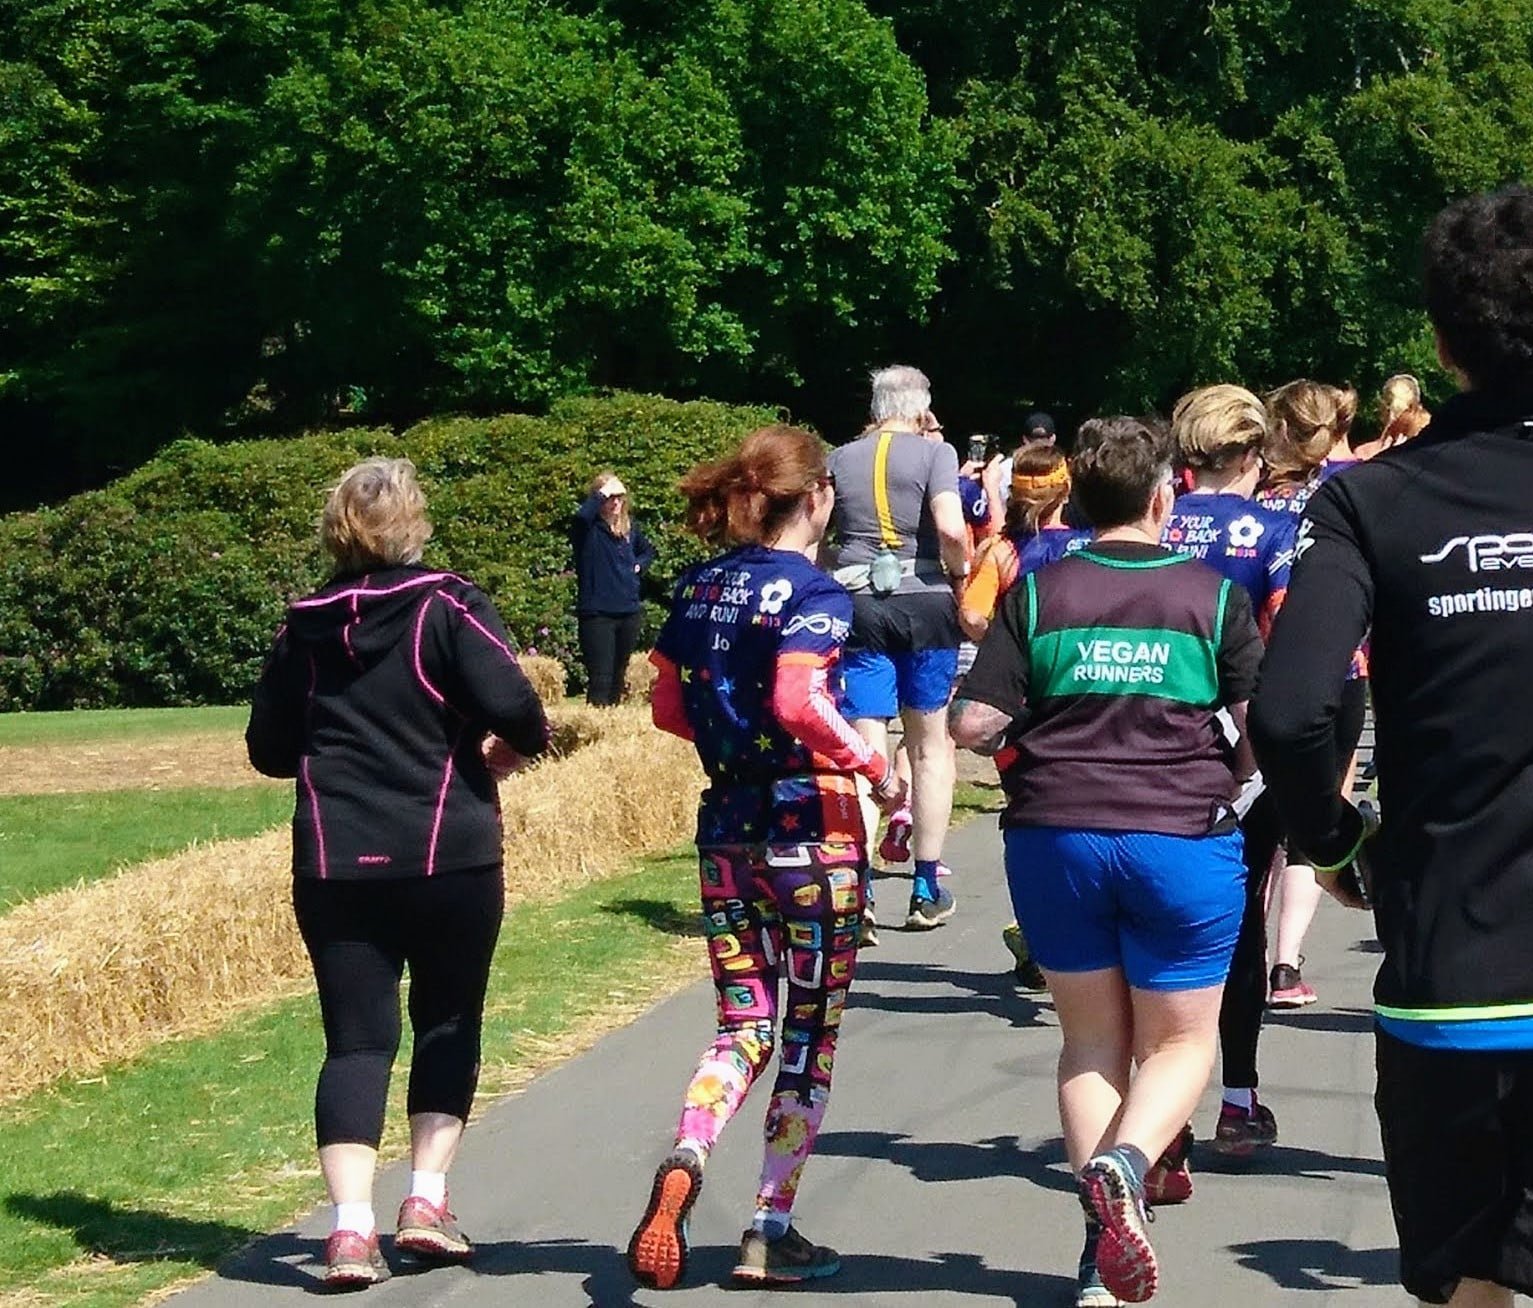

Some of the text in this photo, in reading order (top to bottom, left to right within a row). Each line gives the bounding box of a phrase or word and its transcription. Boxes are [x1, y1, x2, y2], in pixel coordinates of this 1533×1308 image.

[1179, 514, 1215, 530] YOUR
[1185, 529, 1222, 544] BACK
[719, 587, 754, 605] BACK
[710, 604, 740, 624] RUN!
[711, 632, 731, 652] Jo
[1076, 639, 1171, 666] VEGAN
[1073, 663, 1165, 684] RUNNERS
